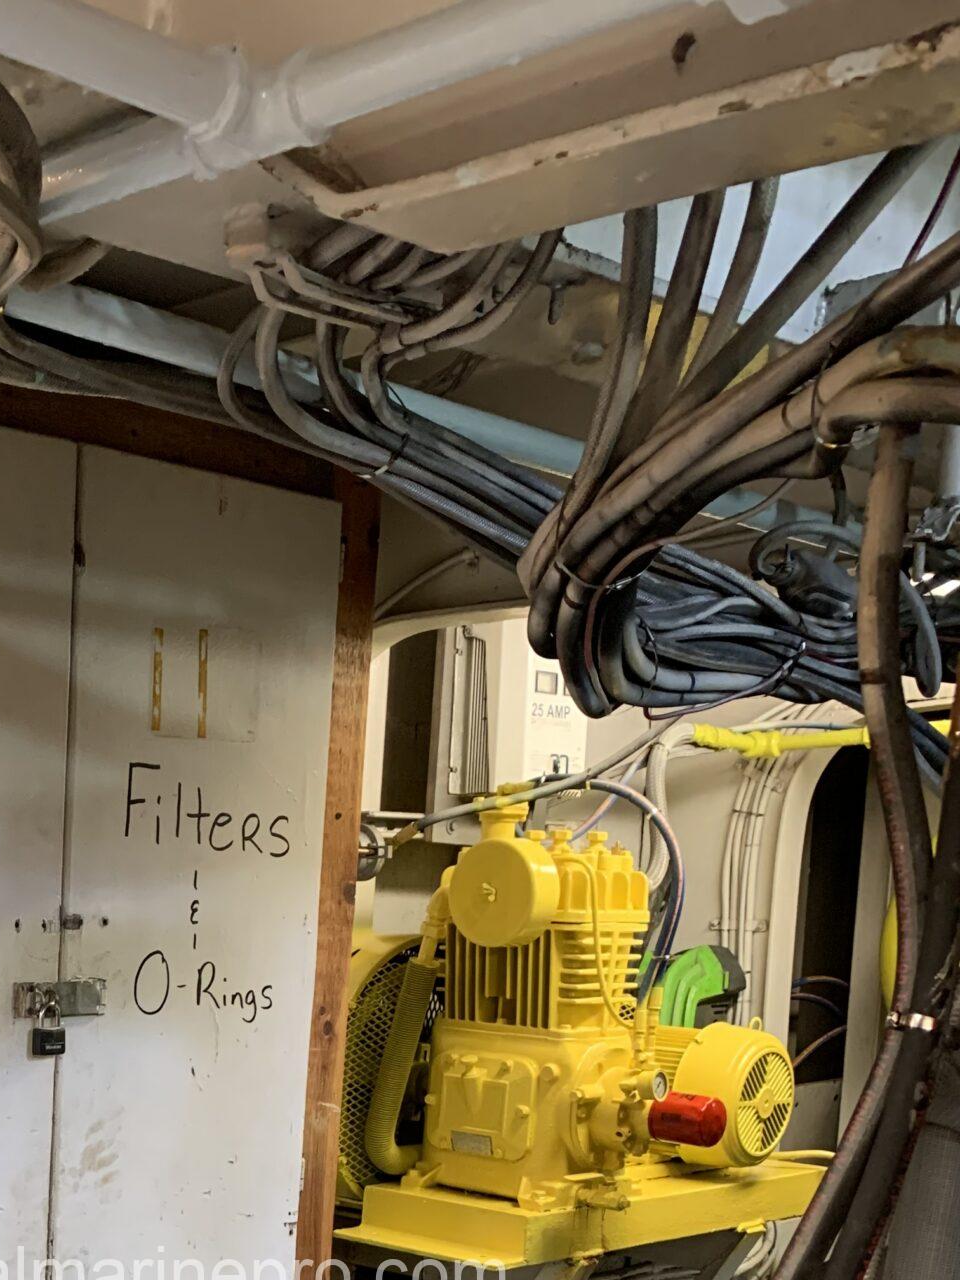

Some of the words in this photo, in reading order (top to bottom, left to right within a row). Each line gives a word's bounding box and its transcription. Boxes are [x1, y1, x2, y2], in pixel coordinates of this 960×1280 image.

[531, 703, 544, 717] 25
[546, 704, 571, 719] AMP
[134, 950, 273, 1023] O-Rings
